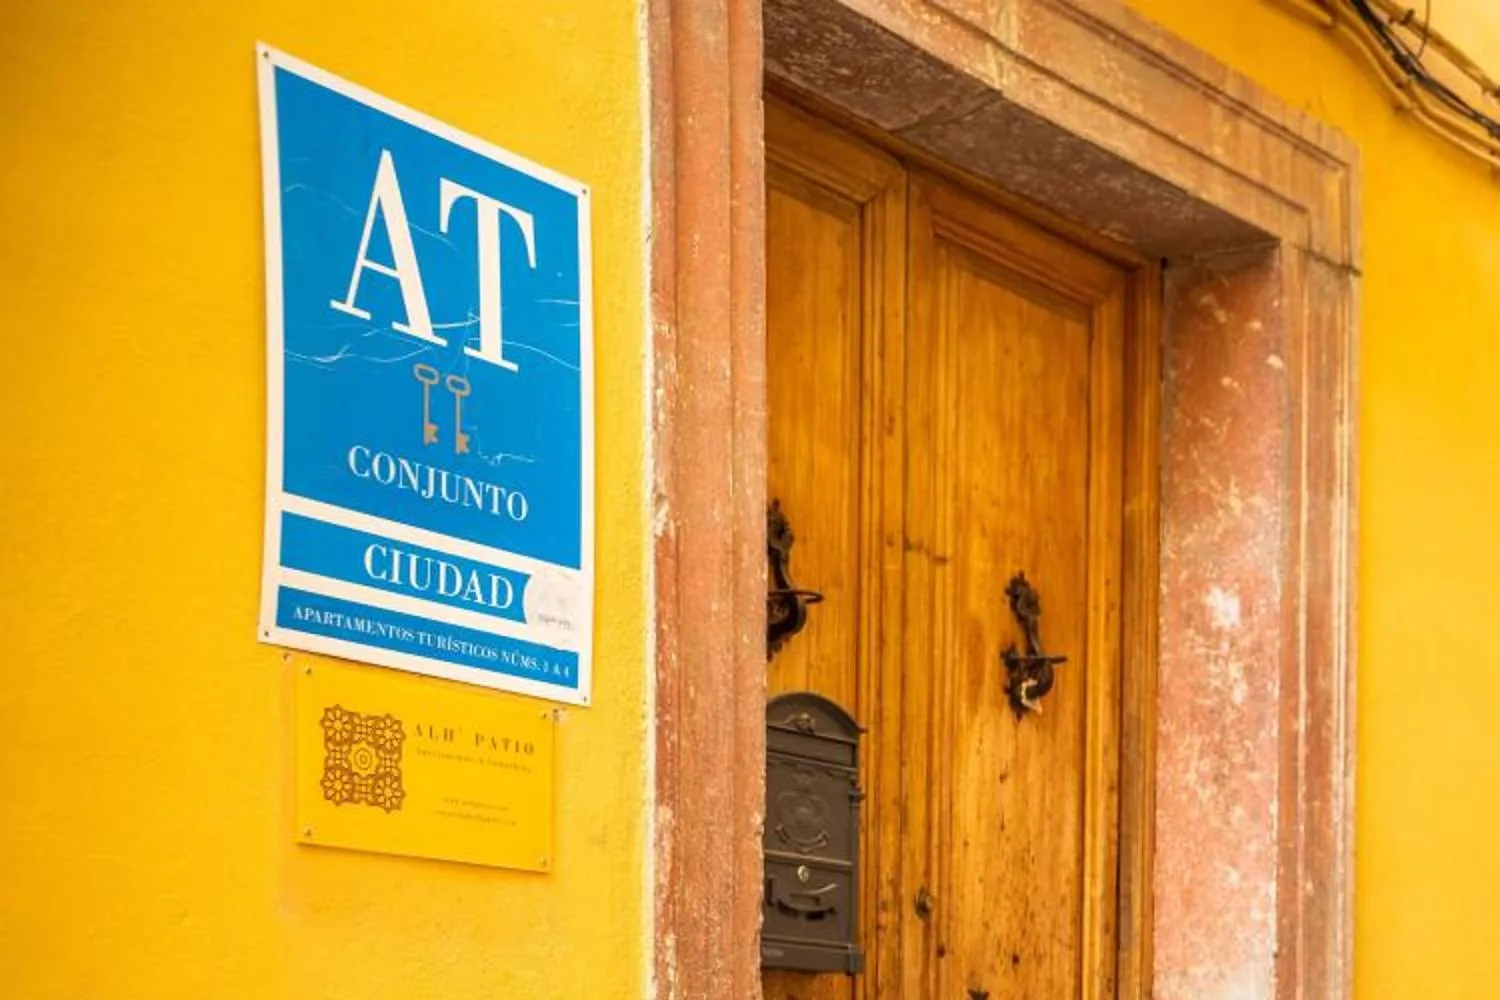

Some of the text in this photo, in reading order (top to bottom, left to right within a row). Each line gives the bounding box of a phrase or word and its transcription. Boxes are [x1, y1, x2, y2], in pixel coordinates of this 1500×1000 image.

[329, 148, 537, 373] AT
[347, 445, 529, 522] CONJUNTO
[363, 543, 514, 610] CIUDAD
[293, 605, 415, 642] APARTAMENTOS
[418, 630, 499, 661] TURÍSTICOS
[474, 731, 535, 755] PATIO
